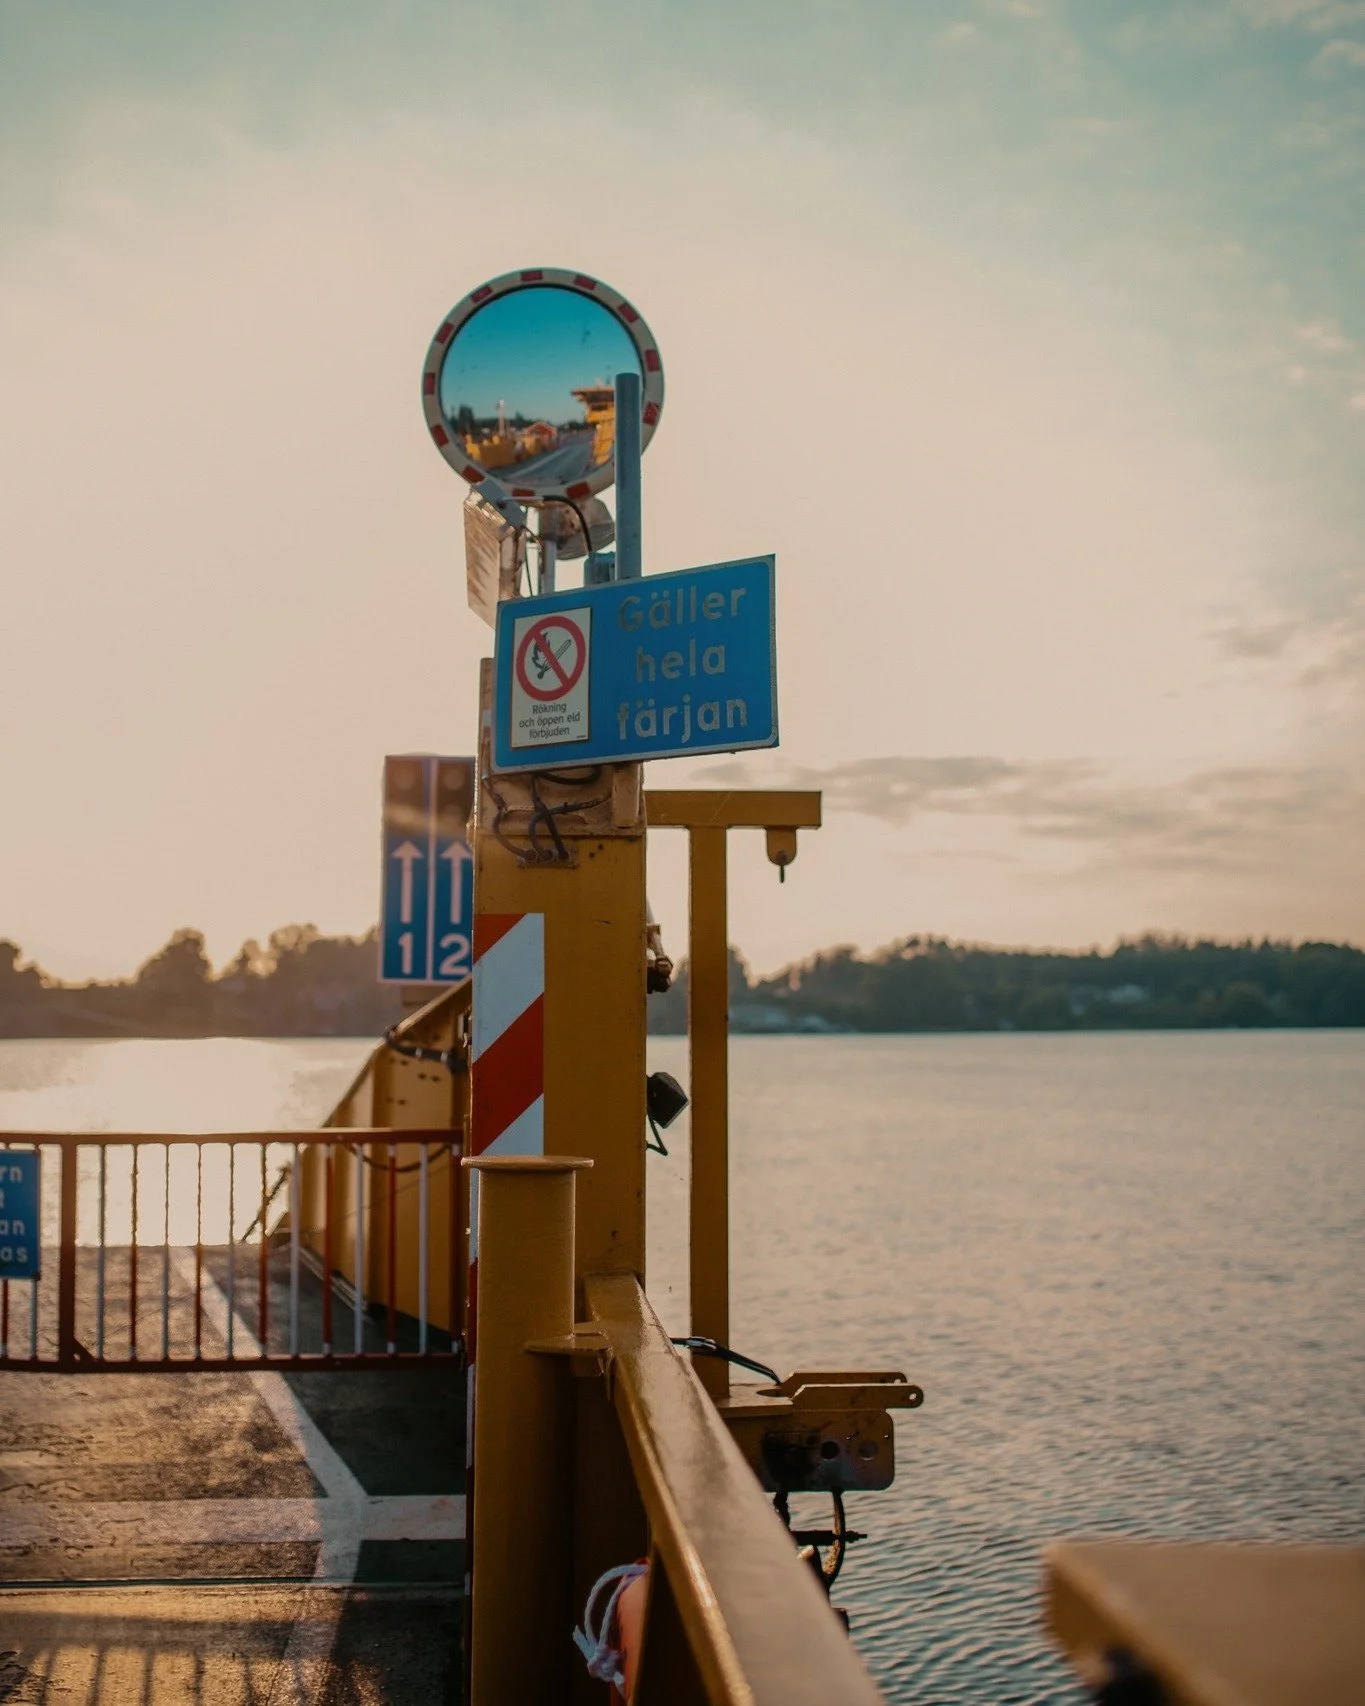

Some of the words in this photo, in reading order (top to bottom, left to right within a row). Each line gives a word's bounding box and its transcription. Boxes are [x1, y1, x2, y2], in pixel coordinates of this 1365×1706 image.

[618, 586, 747, 632] Gäller
[636, 638, 726, 684] hela
[518, 717, 535, 728] och
[537, 715, 564, 728] öppen
[566, 711, 581, 722] eld
[532, 702, 567, 714] Rökning
[617, 694, 748, 744] färjan
[529, 726, 570, 739] förbjuden
[398, 932, 413, 975] 1
[438, 933, 470, 976] 2
[0, 1246, 28, 1263] as
